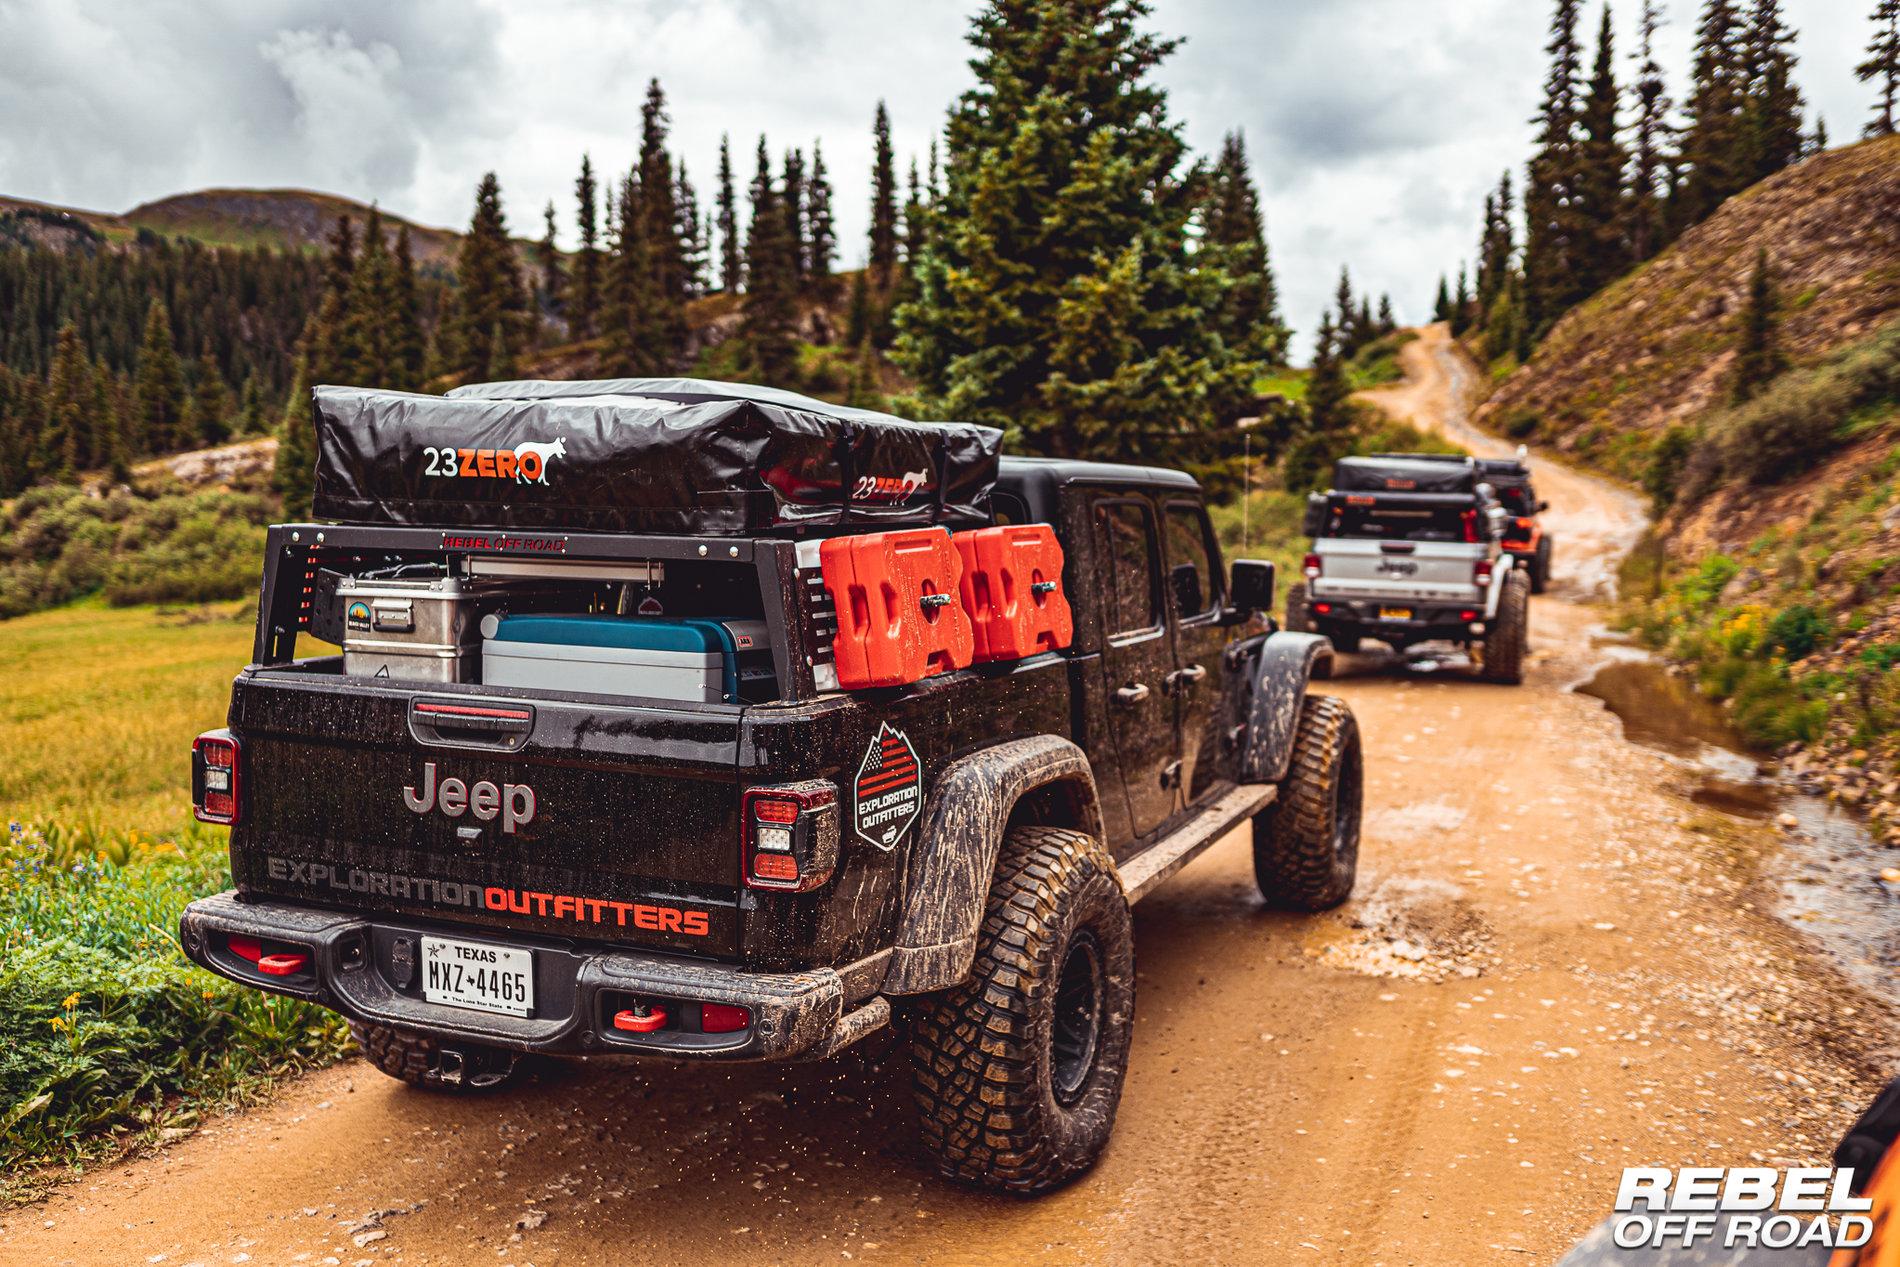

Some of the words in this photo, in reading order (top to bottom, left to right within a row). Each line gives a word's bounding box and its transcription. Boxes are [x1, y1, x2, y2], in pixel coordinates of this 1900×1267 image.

[423, 447, 543, 480] 23ZERO
[852, 475, 914, 500] 23ZERO
[443, 536, 493, 549] REBEL
[494, 537, 522, 550] OFF
[523, 538, 566, 551] ROAD
[403, 762, 536, 834] Jeep
[859, 785, 918, 815] EXPLORATION
[862, 801, 915, 829] OUTFITTERS
[454, 946, 497, 963] TEXAS
